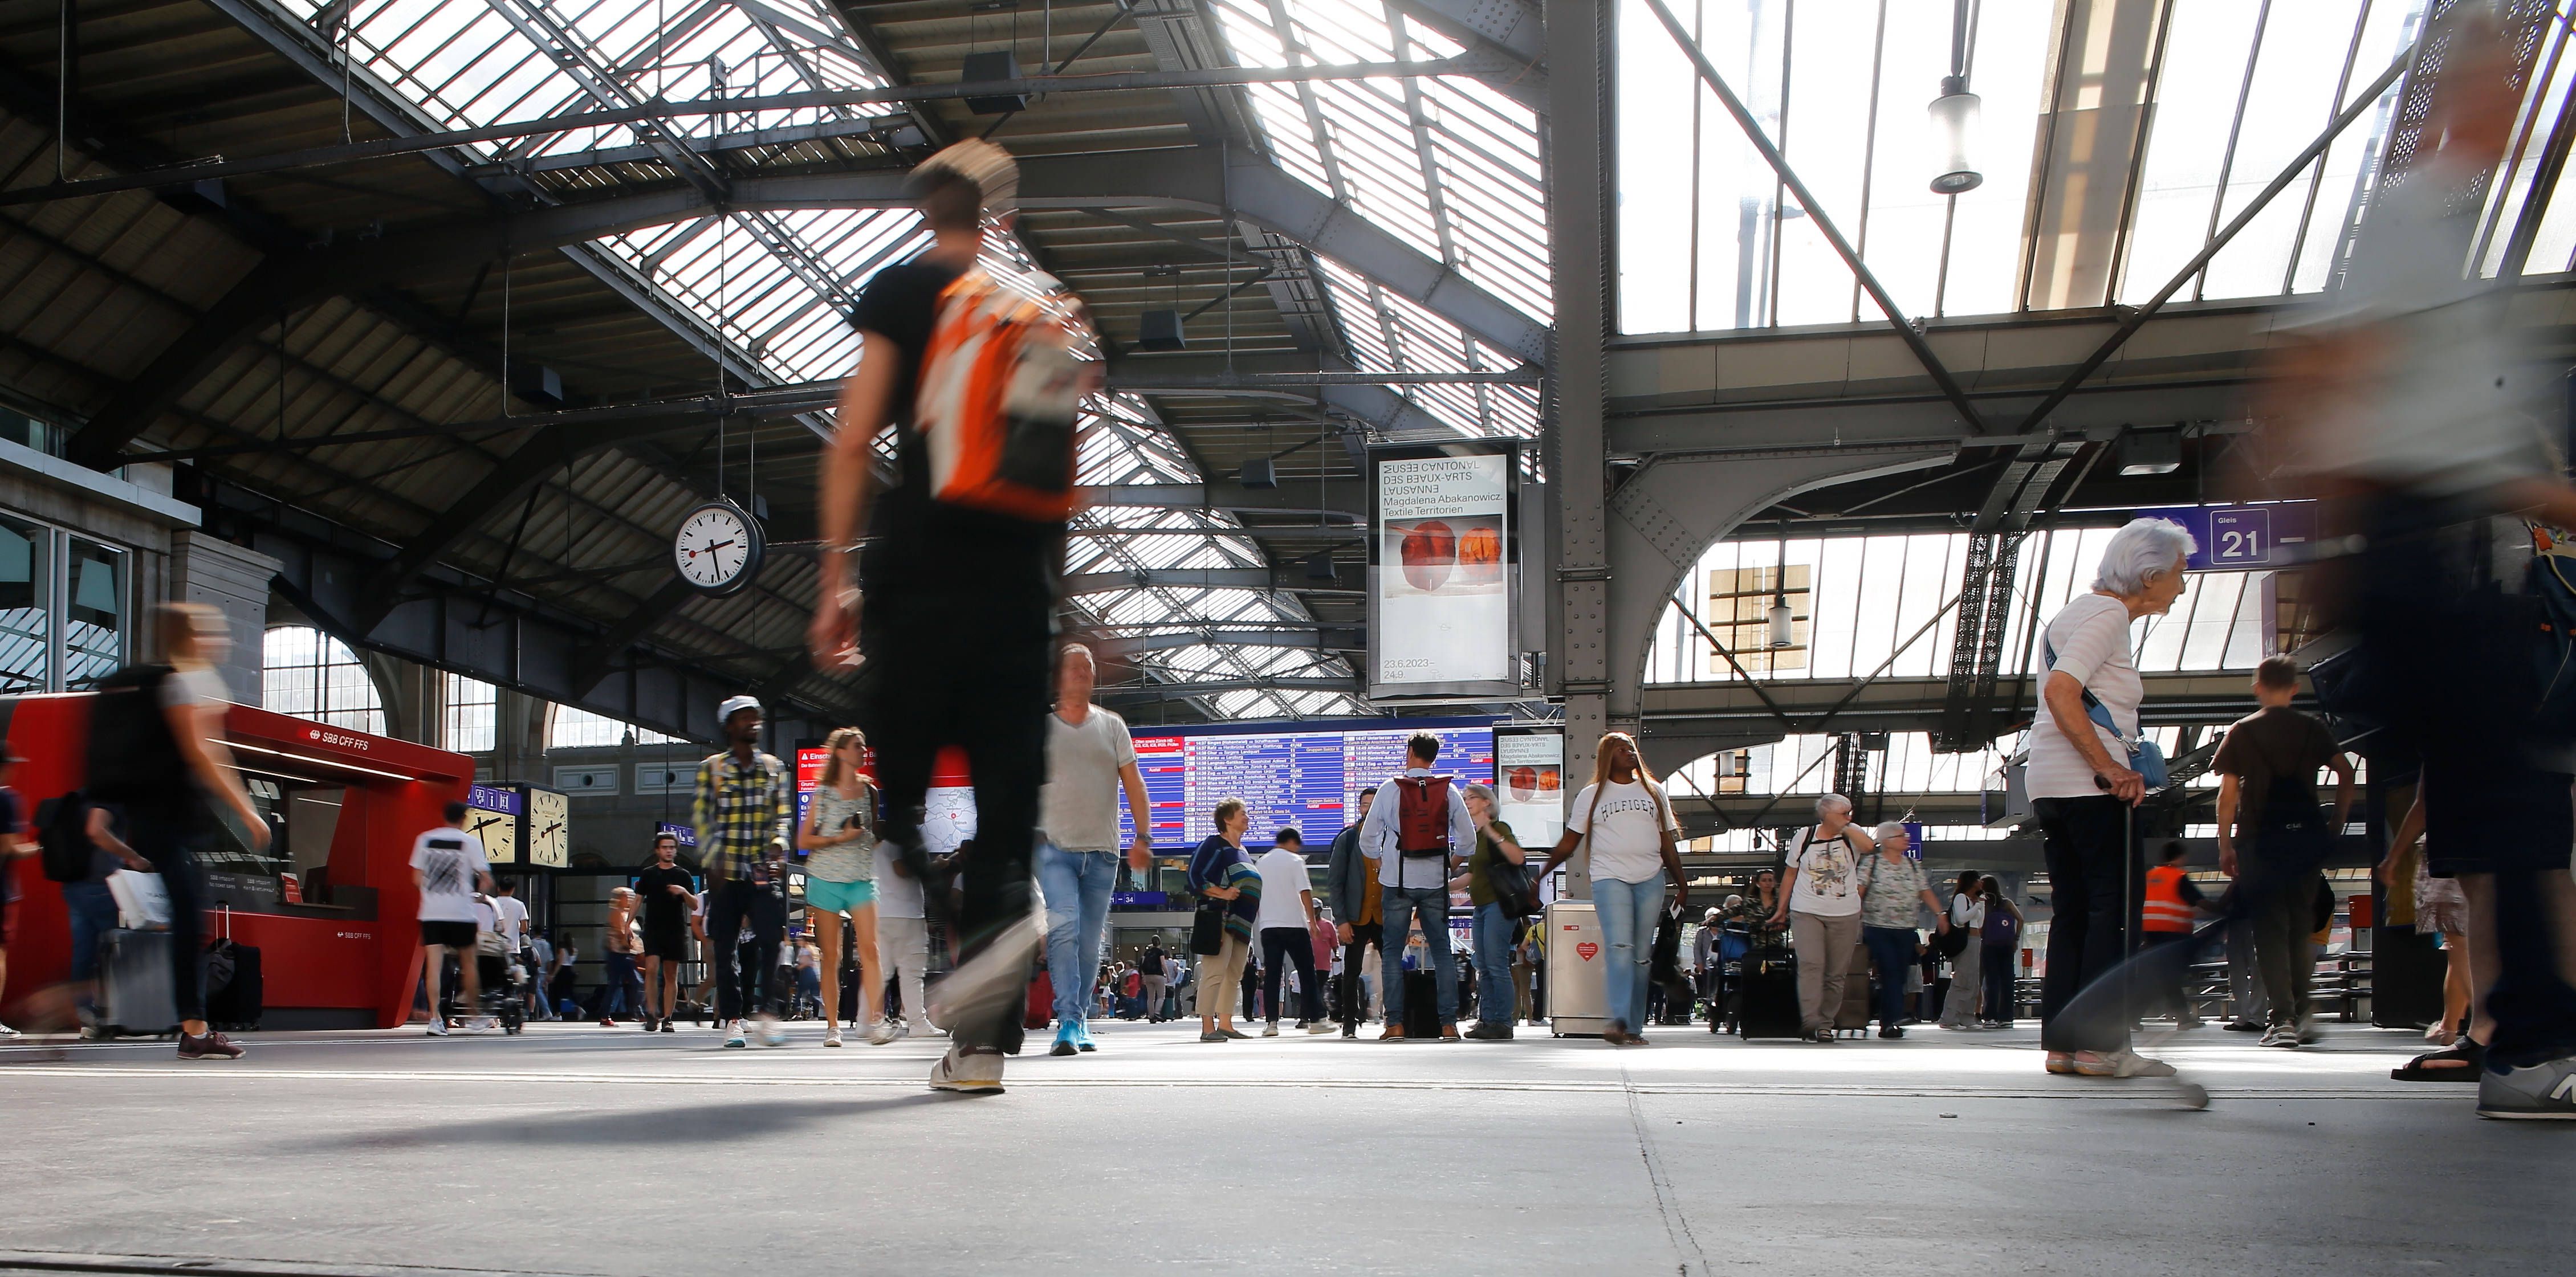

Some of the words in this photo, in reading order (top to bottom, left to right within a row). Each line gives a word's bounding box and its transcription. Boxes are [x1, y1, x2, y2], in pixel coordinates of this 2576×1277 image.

[1384, 475, 1403, 484] DES
[1407, 472, 1472, 483] BEAUX-ARTS
[1384, 485, 1439, 495] LAUSANNE
[1384, 496, 1435, 507] Magdalena
[1438, 492, 1503, 503] Abakanowicz.
[1384, 507, 1413, 516] Textile
[1415, 505, 1463, 515] Territorien
[2221, 531, 2257, 557] 21
[323, 732, 339, 744] SBB
[339, 736, 354, 747] CFF
[354, 739, 369, 750] FFS
[1601, 799, 1654, 822] HILFIGER
[1907, 850, 1916, 858] 11
